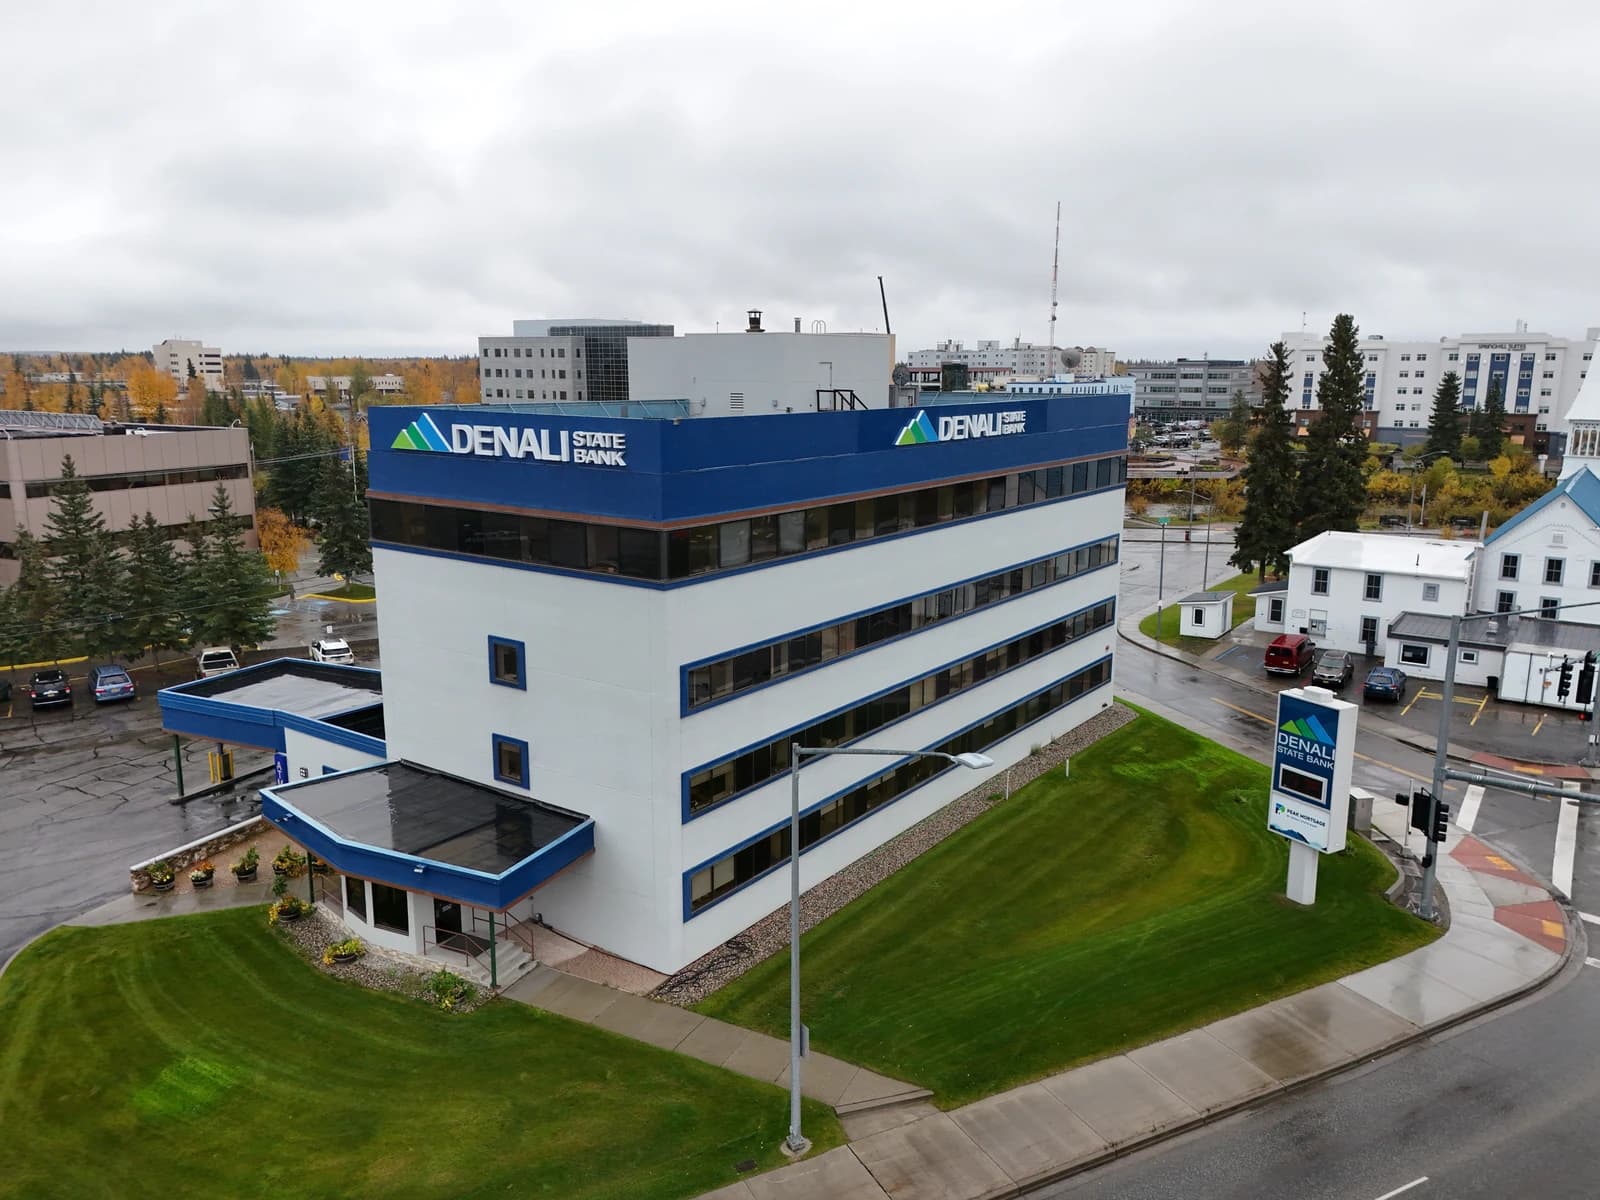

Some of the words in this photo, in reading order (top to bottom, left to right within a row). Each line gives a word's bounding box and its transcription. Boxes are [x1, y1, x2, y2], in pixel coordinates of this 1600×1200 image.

[1001, 410, 1026, 423] STATE
[938, 412, 1001, 442] DENALI
[1001, 422, 1026, 435] BANK
[451, 423, 570, 462] DENALI
[572, 430, 627, 449] STATE
[573, 448, 627, 467] BANK
[1278, 731, 1336, 761] DENALI
[1277, 745, 1304, 761] STATE
[1306, 754, 1335, 770] BANK
[1286, 808, 1300, 817] PEAK
[1299, 814, 1326, 828] MORTGAGE
